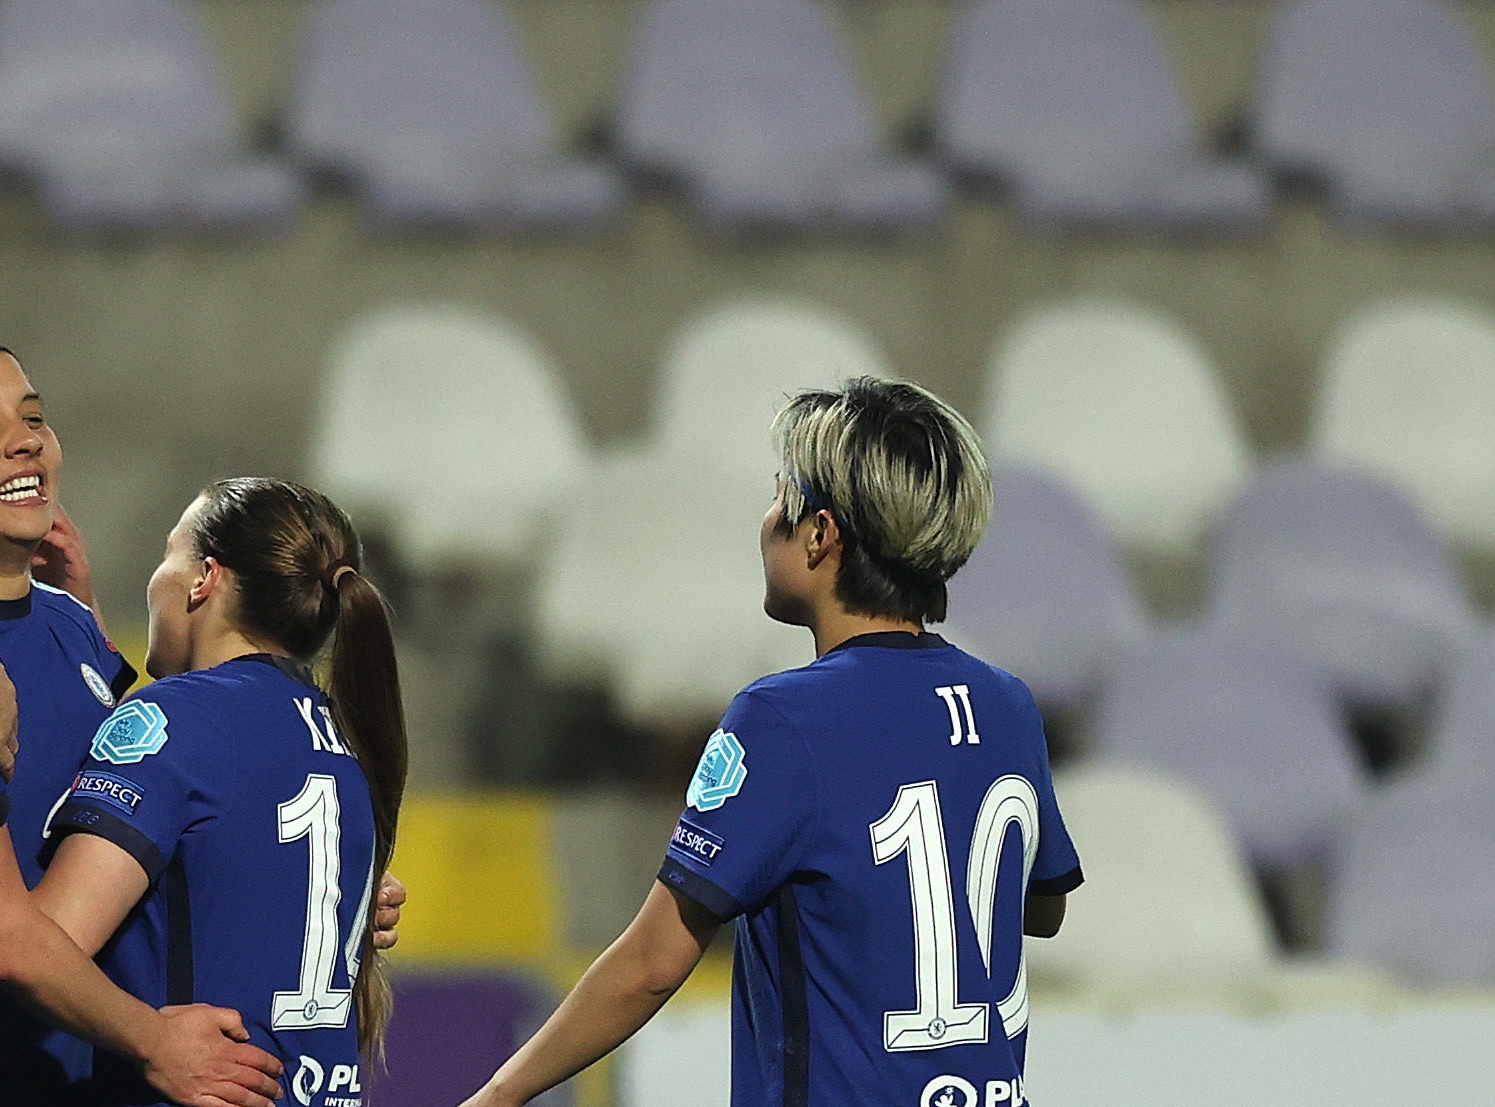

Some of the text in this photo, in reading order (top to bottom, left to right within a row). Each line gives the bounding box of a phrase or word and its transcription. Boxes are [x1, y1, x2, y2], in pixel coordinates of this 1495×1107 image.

[934, 685, 981, 746] JI
[78, 777, 142, 807] RESPECT
[673, 826, 722, 859] RESPECT
[869, 774, 1040, 1052] 10
